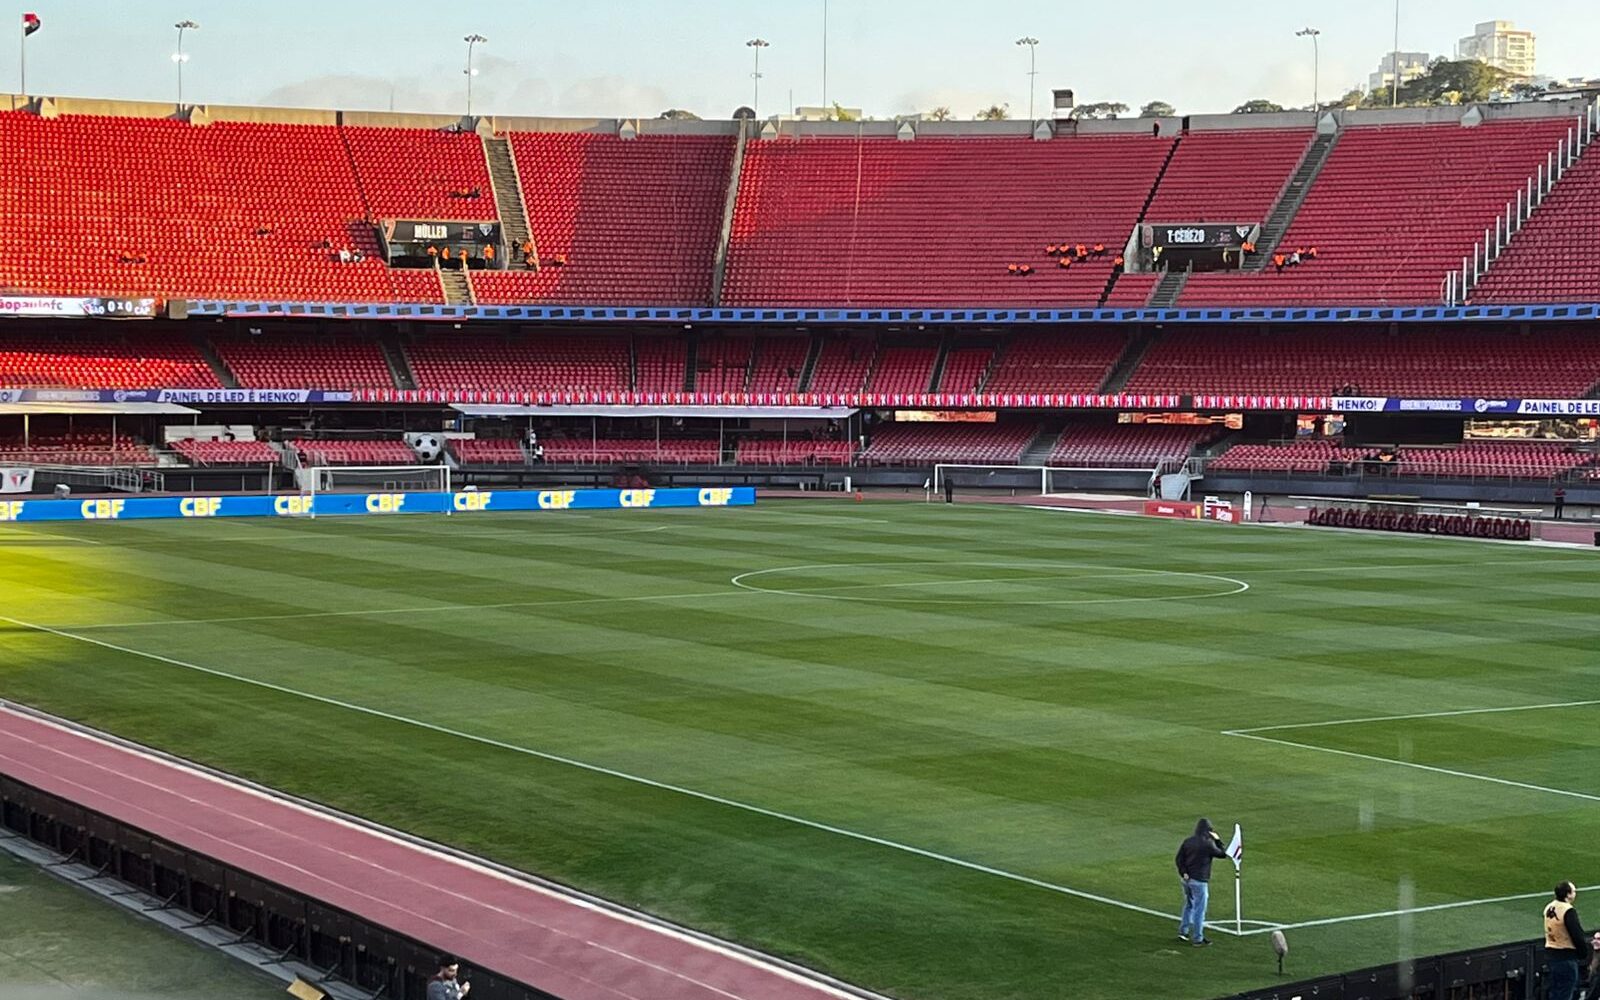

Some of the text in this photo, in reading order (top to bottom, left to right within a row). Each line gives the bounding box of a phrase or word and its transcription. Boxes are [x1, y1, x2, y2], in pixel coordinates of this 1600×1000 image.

[164, 392, 204, 402] PAINEL
[207, 392, 221, 402] DE
[224, 391, 245, 402] LED
[259, 392, 300, 402] HENKO!
[1337, 400, 1377, 410] HENKO!
[1525, 402, 1600, 413] PAINEL DE LE
[274, 495, 313, 514] CBF
[365, 493, 406, 512] CBF
[453, 491, 493, 510] CBF
[538, 490, 576, 509] CBF
[619, 488, 656, 507] CBF
[698, 487, 734, 505] CBF
[81, 499, 125, 519] CBF
[179, 497, 223, 516] CBF
